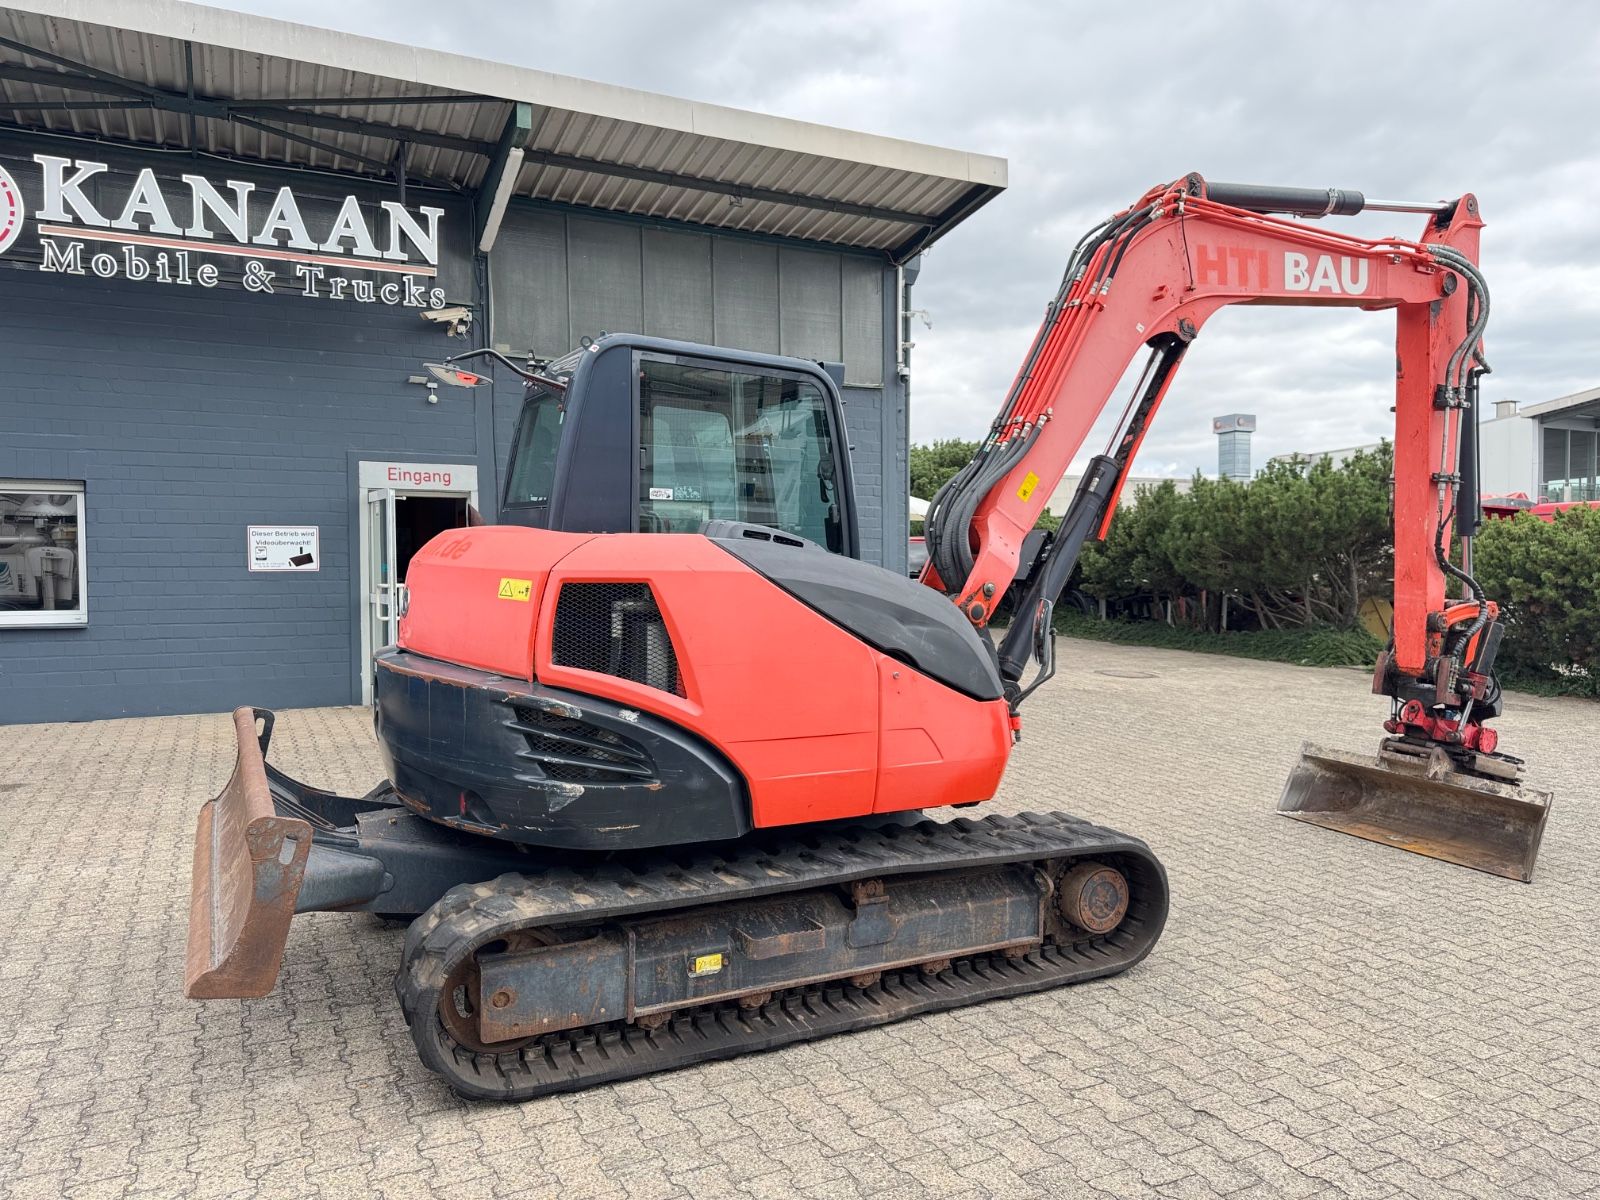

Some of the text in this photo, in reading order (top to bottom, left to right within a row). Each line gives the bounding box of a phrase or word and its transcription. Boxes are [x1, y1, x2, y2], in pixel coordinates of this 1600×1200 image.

[33, 153, 445, 266] KANAAN
[39, 238, 447, 309] Mobile & Trucks
[1195, 244, 1369, 295] HTI BAU
[387, 467, 452, 487] Eingang
